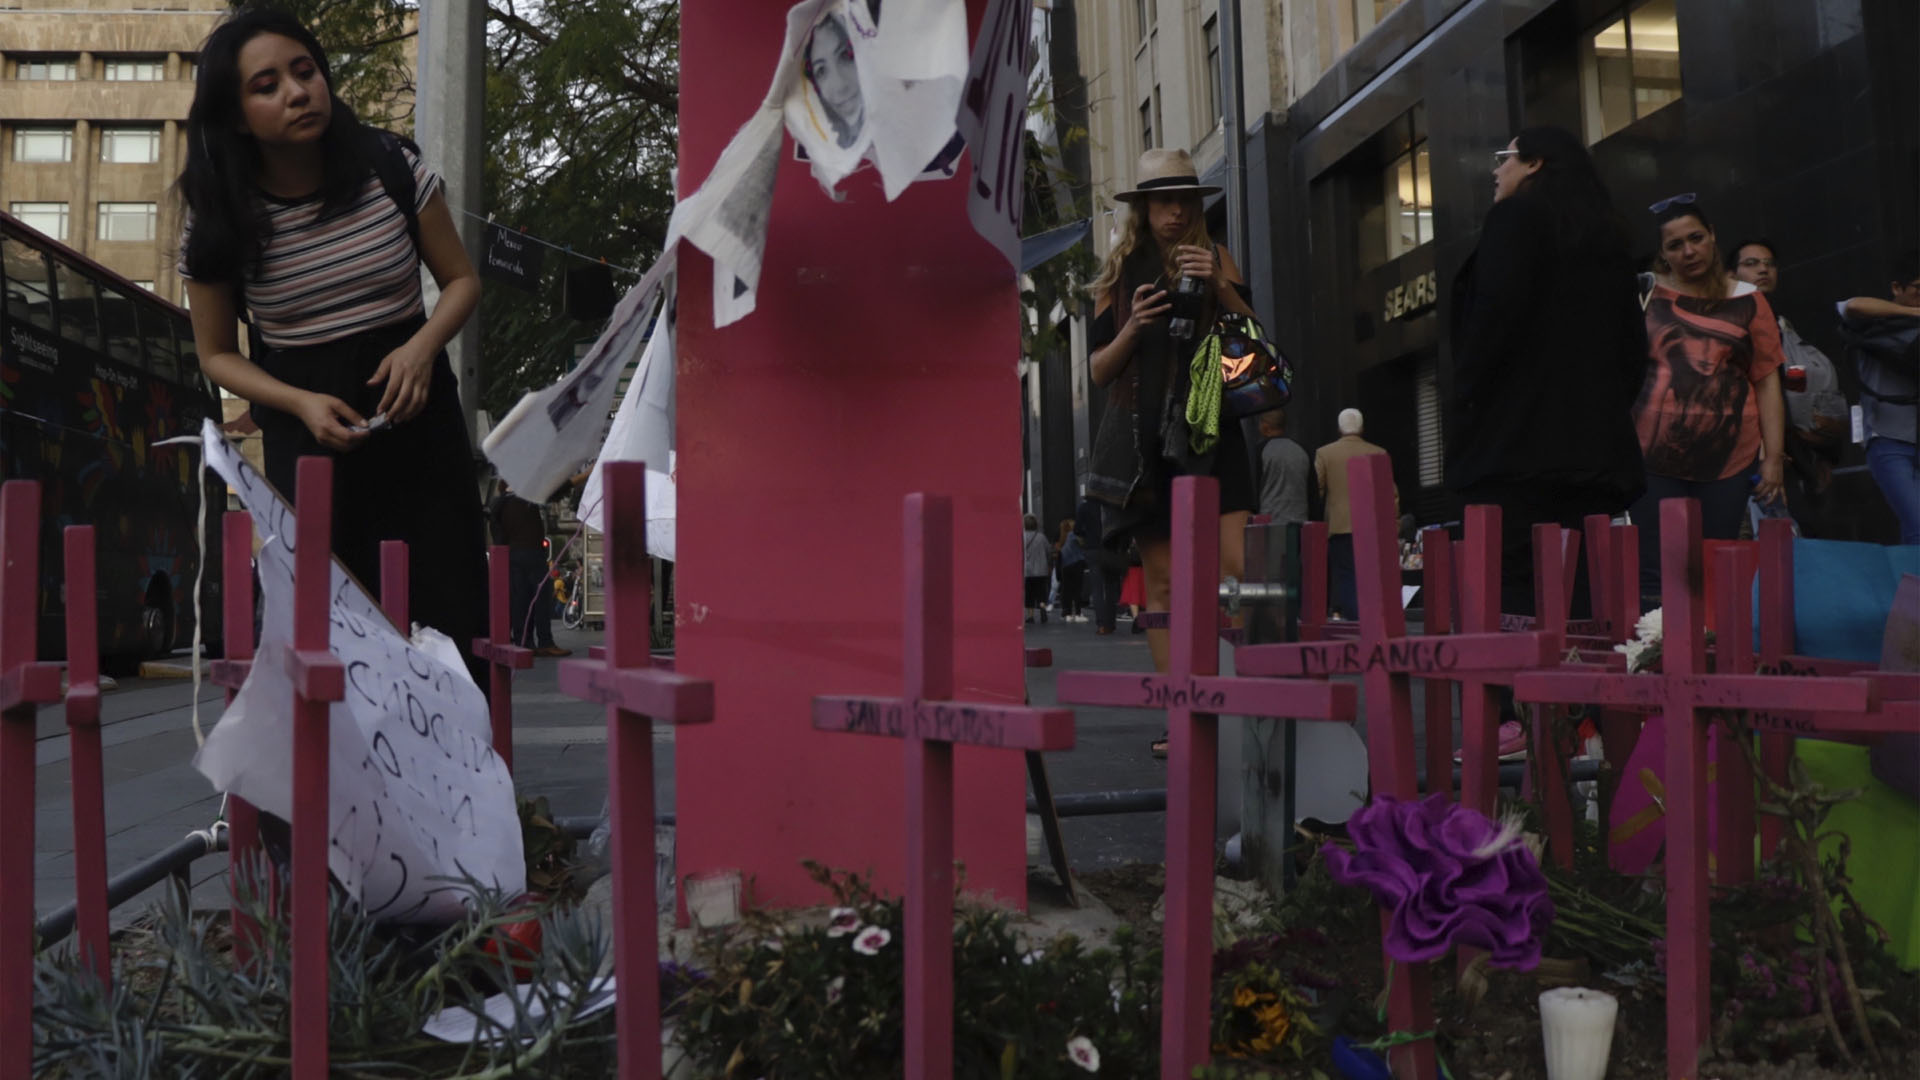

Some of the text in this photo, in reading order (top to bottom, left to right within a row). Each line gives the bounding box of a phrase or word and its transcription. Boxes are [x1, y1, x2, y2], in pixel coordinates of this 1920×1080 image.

[1384, 269, 1437, 322] SEARS
[11, 326, 59, 365] Sightseeing
[1300, 641, 1459, 674] DURANGO
[845, 700, 880, 734] SAN
